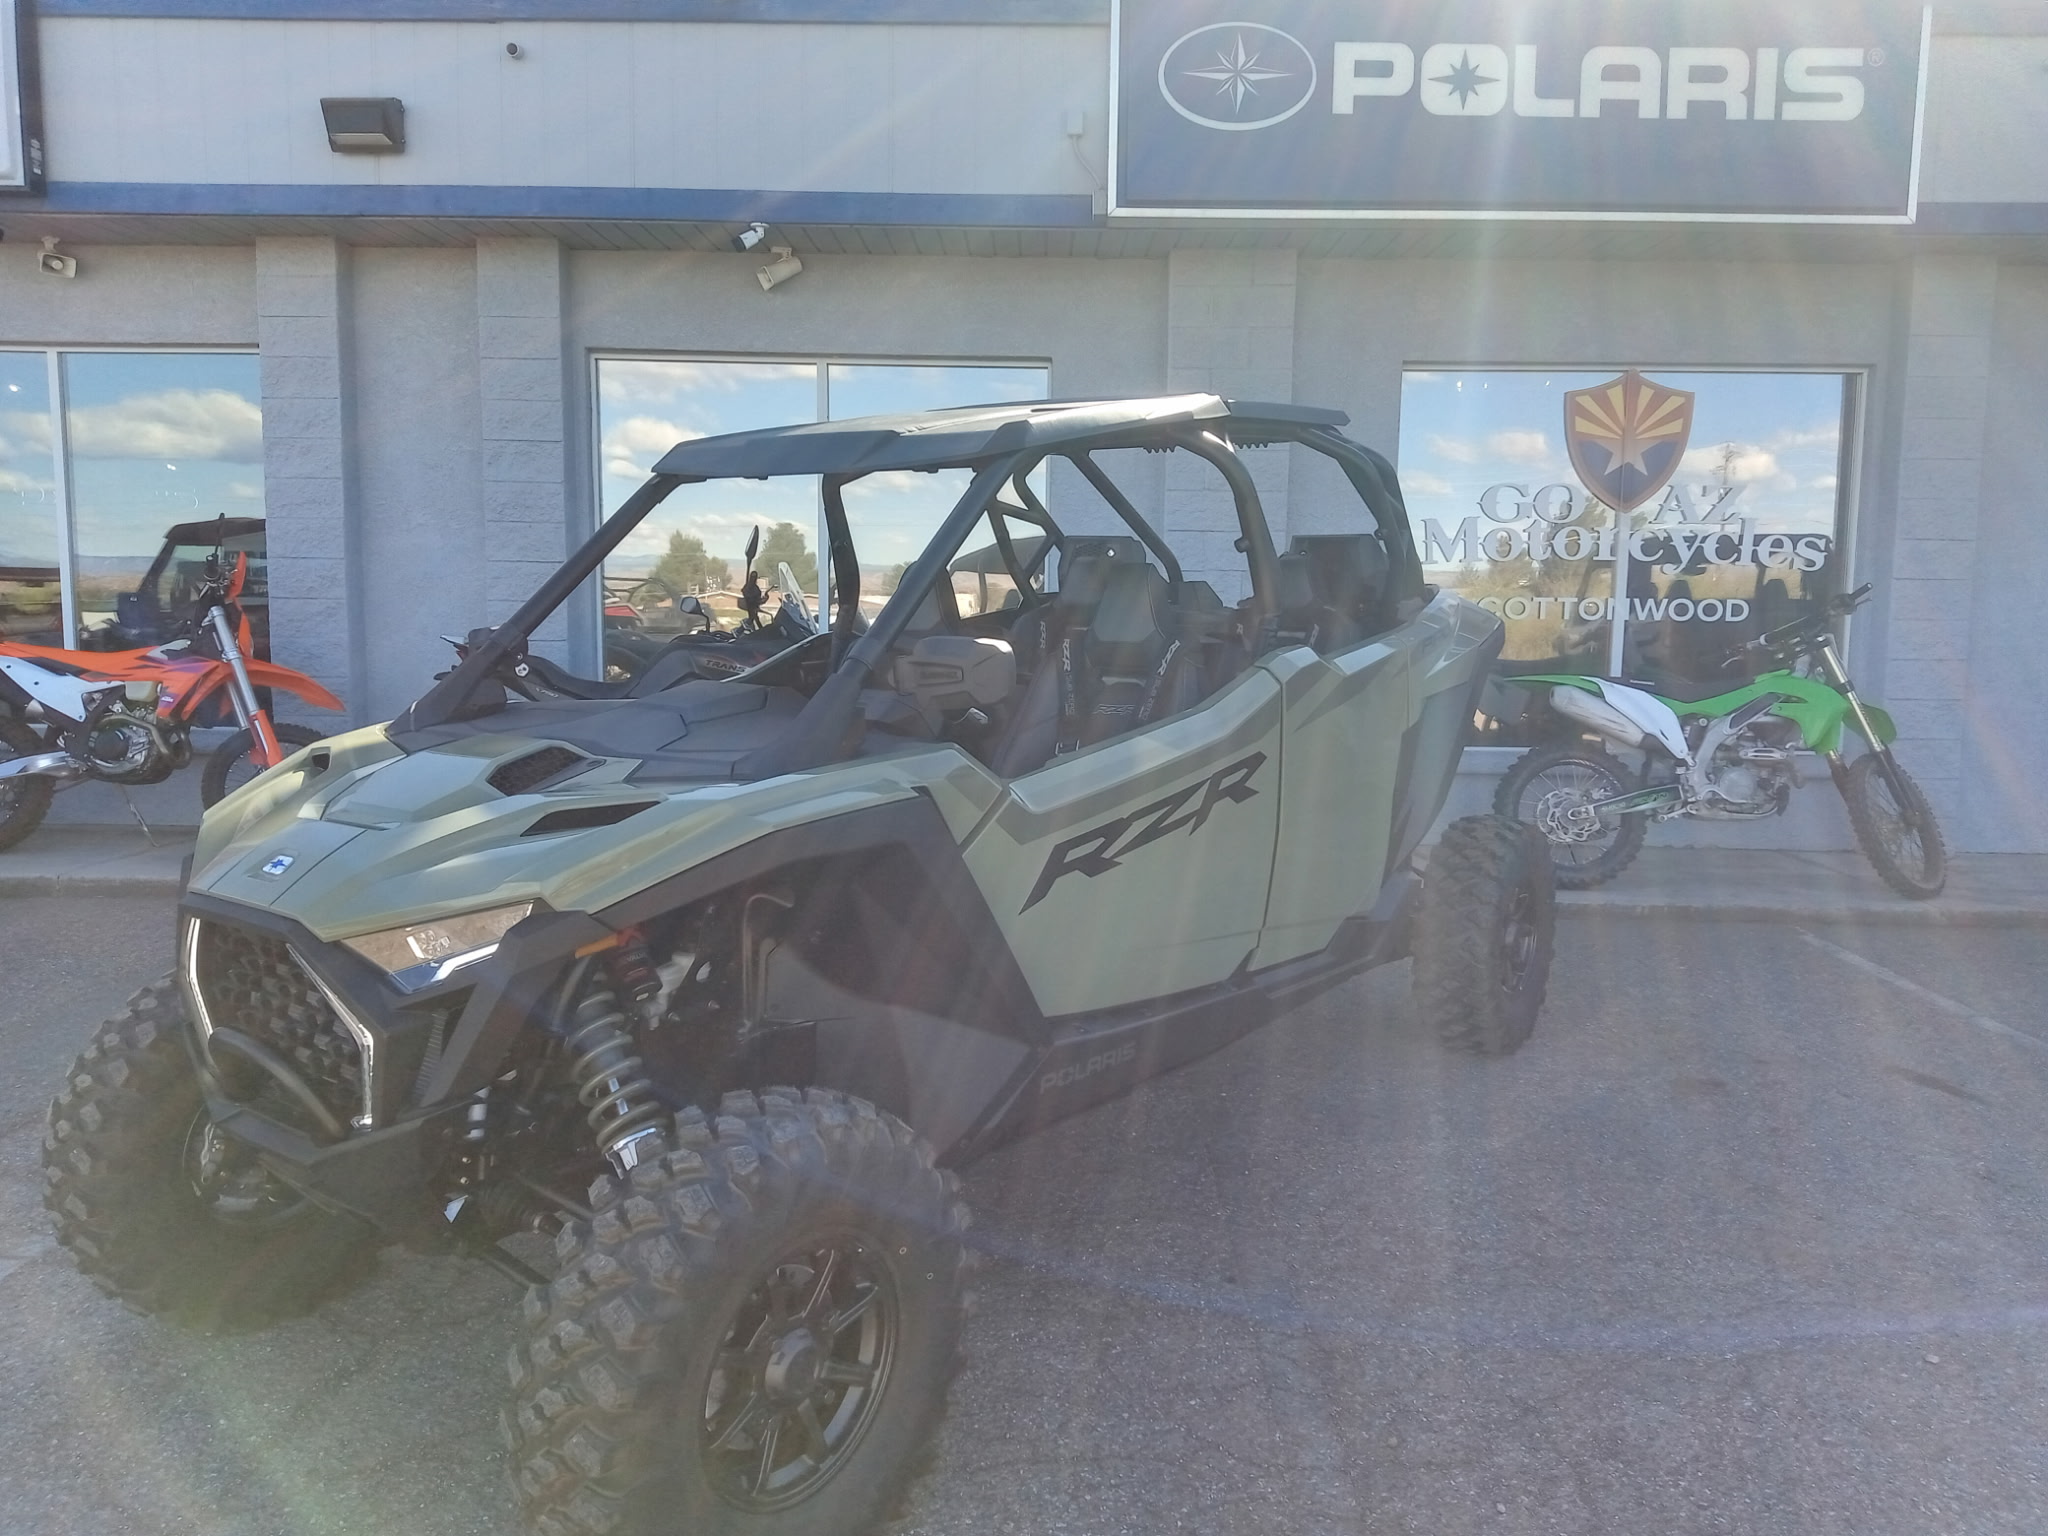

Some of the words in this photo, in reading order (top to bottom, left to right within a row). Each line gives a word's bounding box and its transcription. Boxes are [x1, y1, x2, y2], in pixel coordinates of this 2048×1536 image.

[1331, 41, 1865, 121] POLARIS
[1476, 482, 1588, 524] GO
[1648, 484, 1749, 525] AZ
[1420, 514, 1829, 576] Motorcycles
[1477, 596, 1750, 622] COTTONWOOD
[1062, 638, 1071, 672] RZR
[1157, 639, 1180, 676] RZR
[1017, 751, 1267, 916] RZR
[1039, 1041, 1137, 1095] POLARIS
